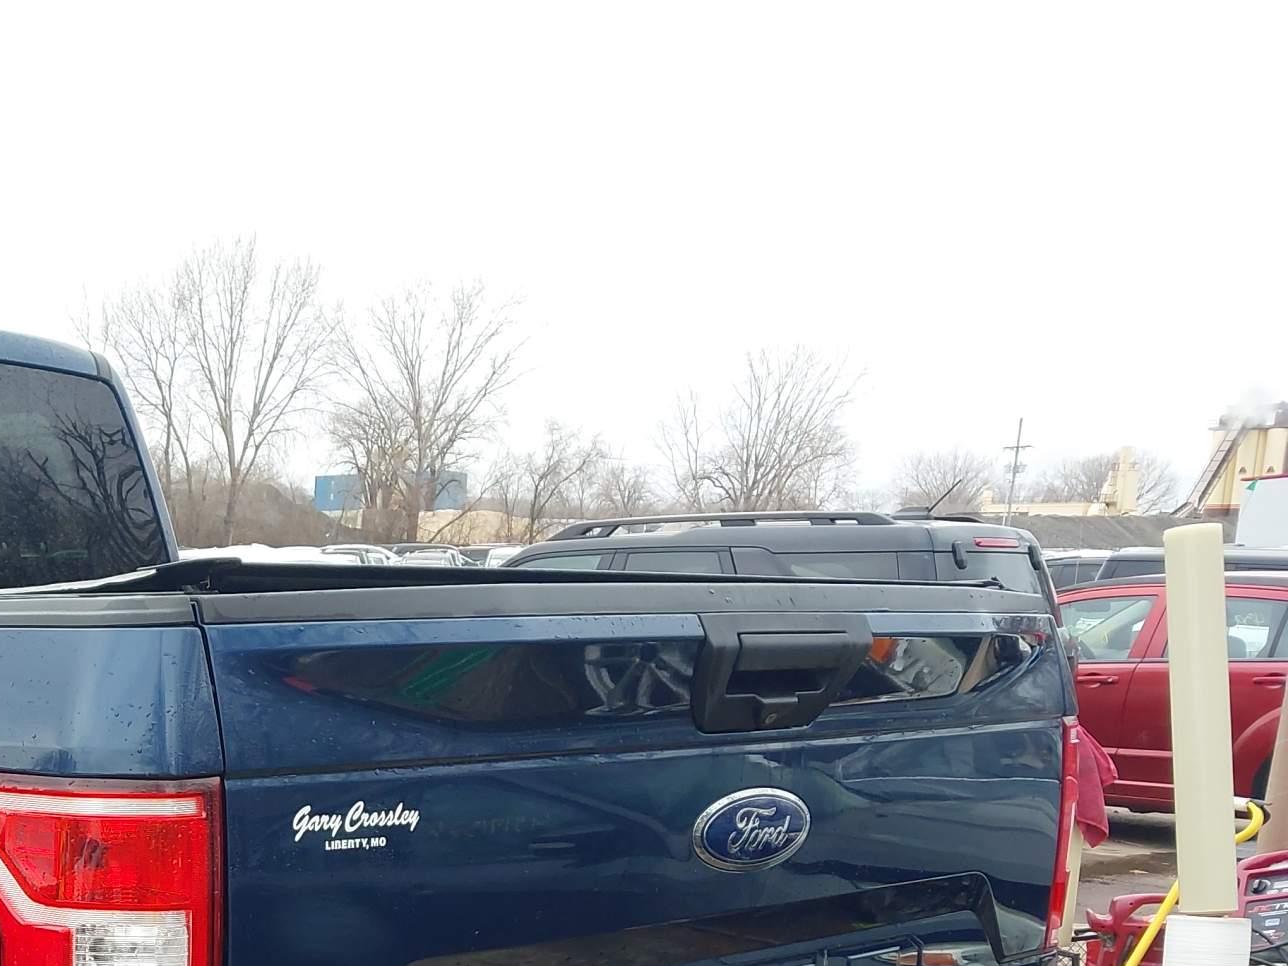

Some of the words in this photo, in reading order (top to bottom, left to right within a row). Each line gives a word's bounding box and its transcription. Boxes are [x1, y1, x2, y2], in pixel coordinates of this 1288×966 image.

[292, 805, 342, 842] Gary
[344, 801, 420, 832] Crossley
[325, 839, 370, 850] LIBERTY,
[371, 836, 387, 848] MO
